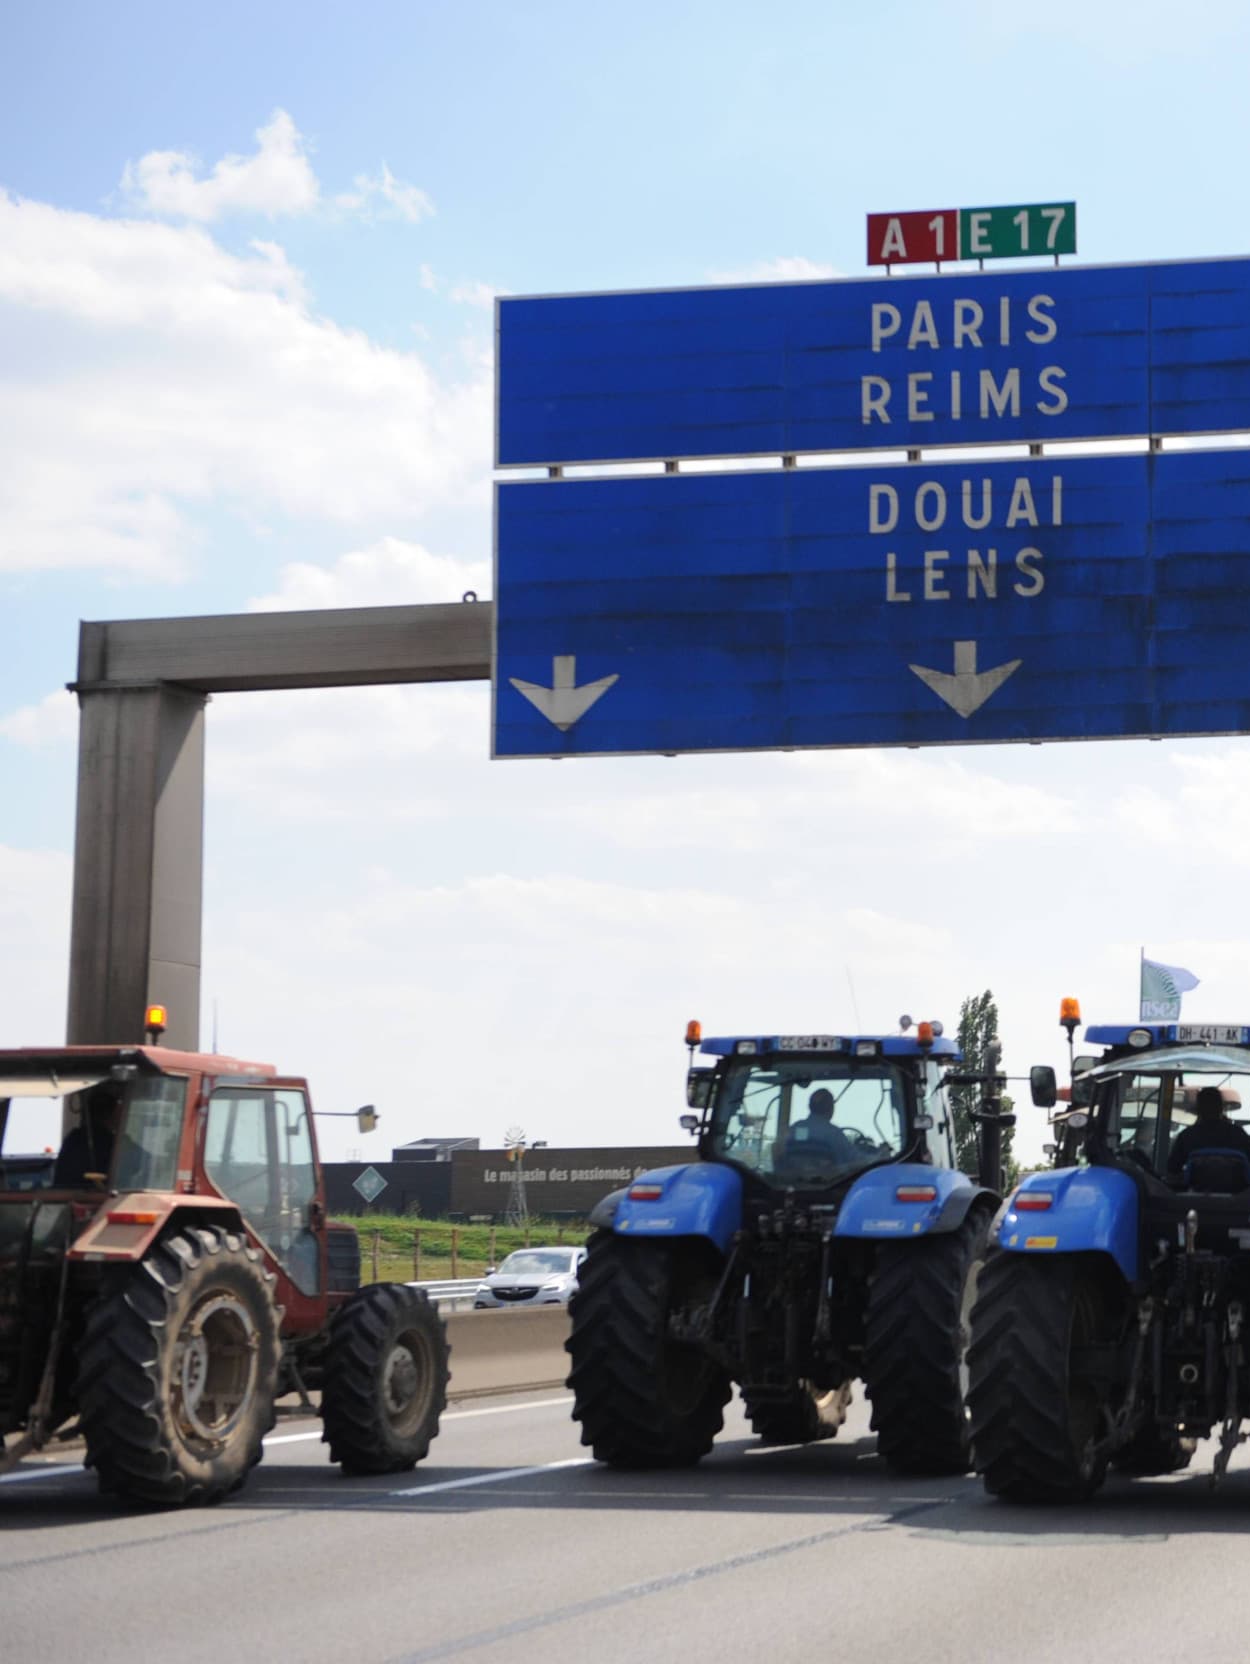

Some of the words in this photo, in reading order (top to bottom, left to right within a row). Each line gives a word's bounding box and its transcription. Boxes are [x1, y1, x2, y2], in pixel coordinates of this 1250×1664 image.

[880, 217, 908, 259] A
[928, 214, 945, 256] 1
[969, 211, 993, 254] E
[1012, 207, 1066, 251] 17
[871, 294, 1058, 353] PARIS
[860, 365, 1069, 425] REIMS
[868, 474, 1063, 535] DOUAI
[885, 546, 1045, 602] LENS
[484, 1169, 497, 1183] Le
[500, 1168, 547, 1183] magasin
[549, 1167, 569, 1182] des
[571, 1165, 632, 1183] passionnés
